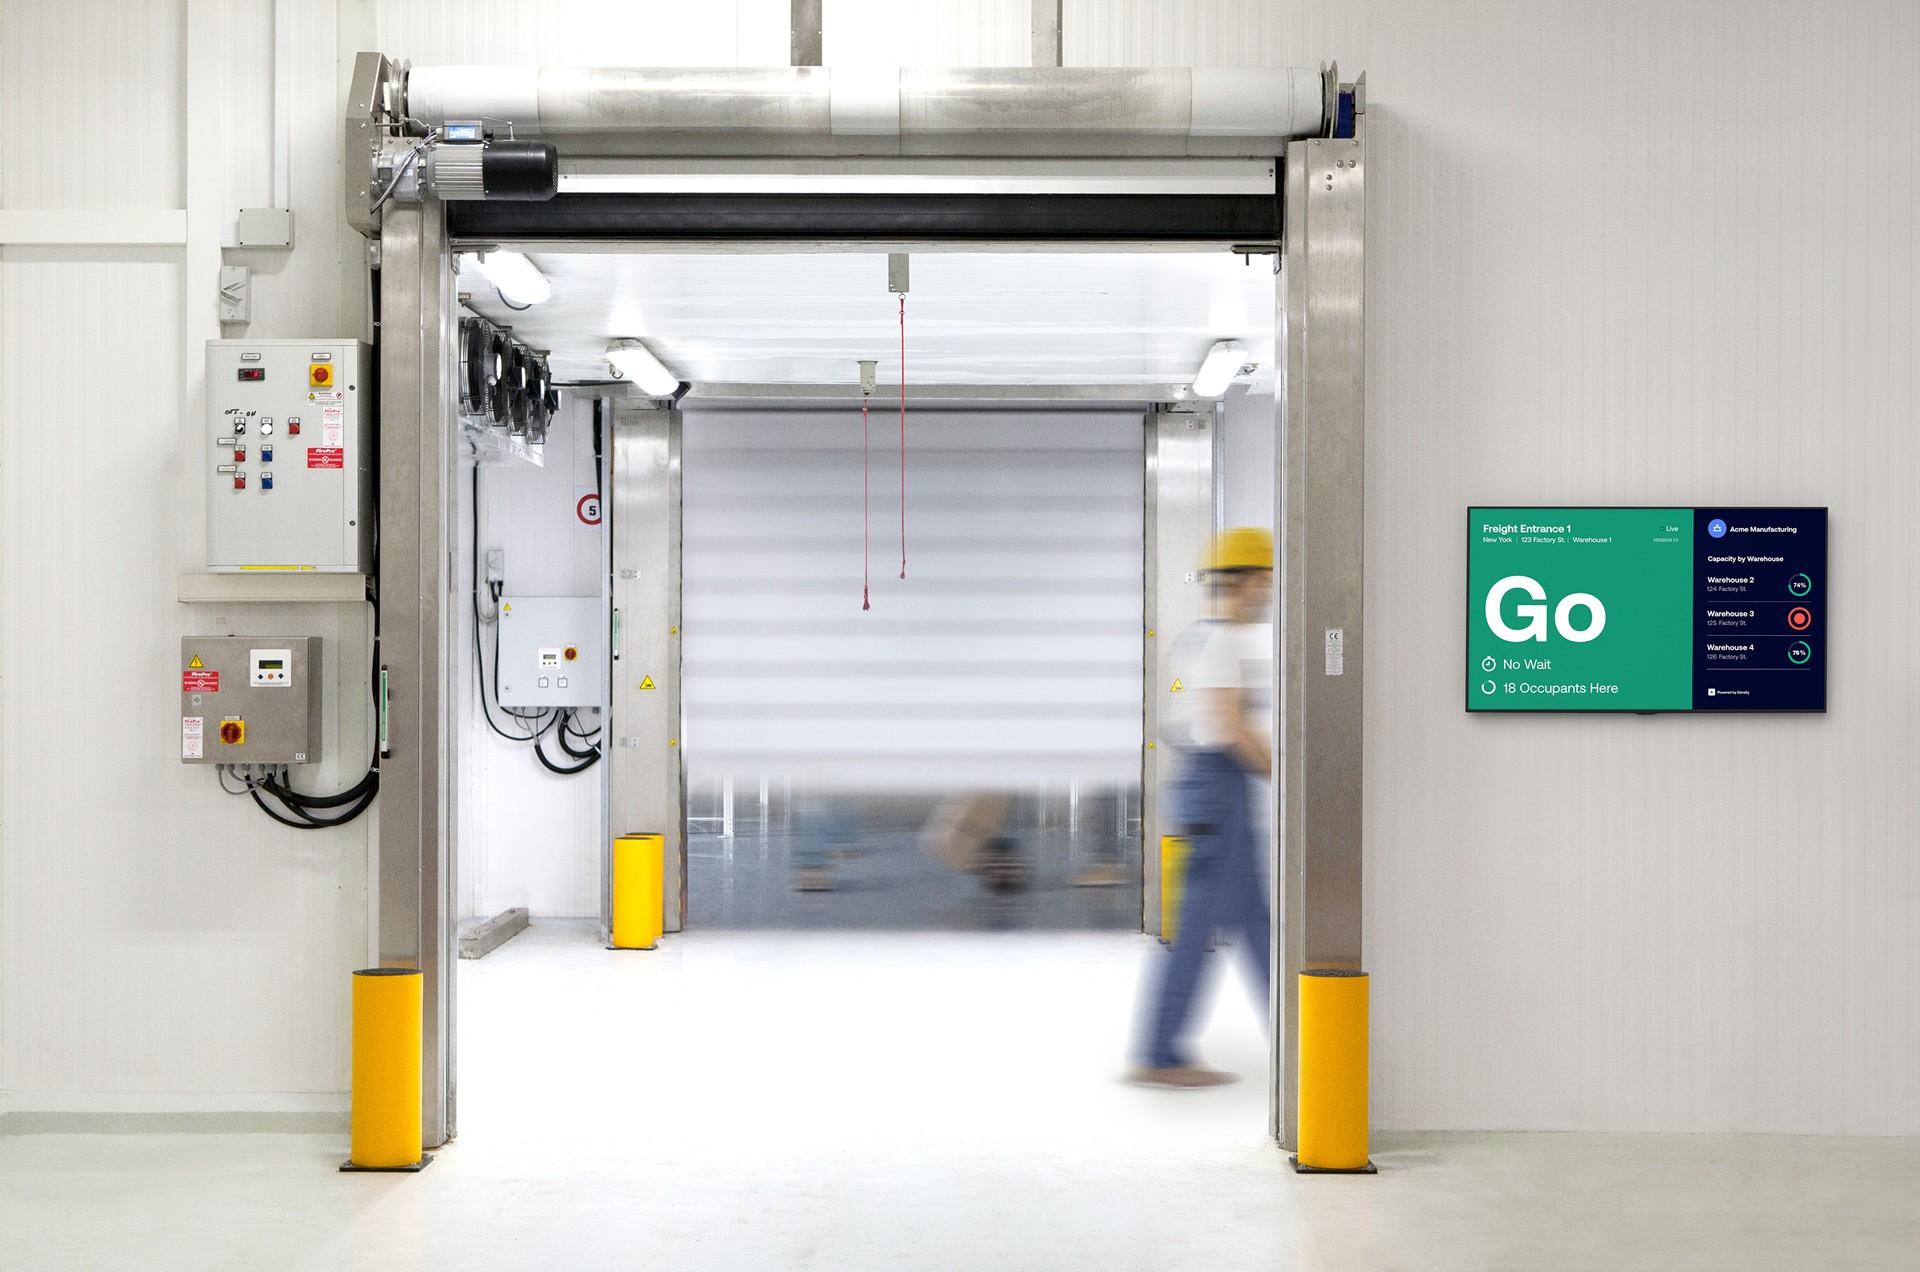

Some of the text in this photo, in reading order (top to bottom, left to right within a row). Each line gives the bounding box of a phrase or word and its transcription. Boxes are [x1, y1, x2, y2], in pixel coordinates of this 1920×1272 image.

[589, 506, 596, 516] 5
[1483, 524, 1571, 535] Freight Entrance 1
[1750, 526, 1797, 534] Manufacturing
[1485, 575, 1606, 642] Go
[1503, 659, 1551, 670] No Wait
[1503, 683, 1618, 696] 18 Occupants Here
